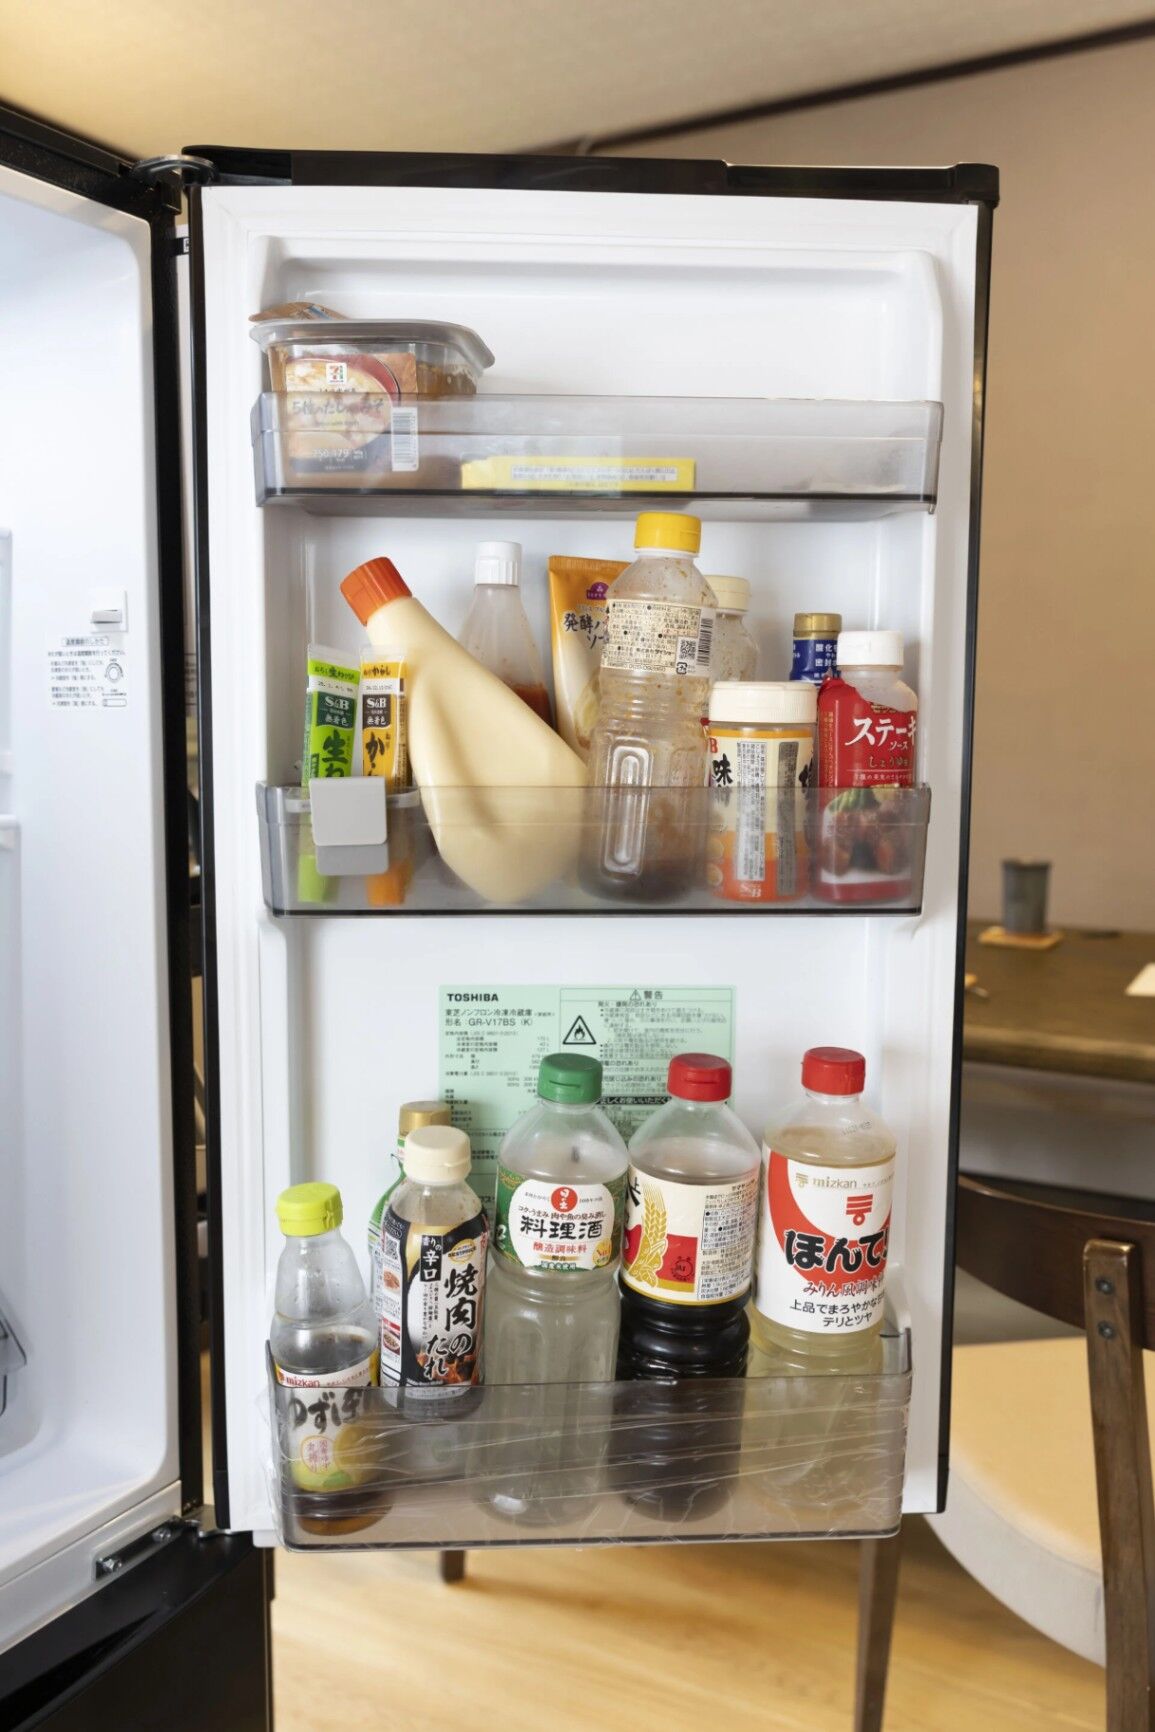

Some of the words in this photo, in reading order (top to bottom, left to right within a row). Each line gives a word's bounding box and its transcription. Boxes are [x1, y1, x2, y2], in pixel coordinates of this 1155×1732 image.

[324, 696, 350, 711] S&B
[366, 697, 386, 709] S&B
[887, 741, 909, 751] ソース
[447, 993, 499, 1002] TOSHIBA
[468, 1018, 516, 1027] GR-V17BS
[812, 1176, 858, 1190] mizkan
[520, 1215, 604, 1240] 料理酒
[422, 1249, 440, 1280] 辛口
[822, 1311, 873, 1328] テリとツヤ
